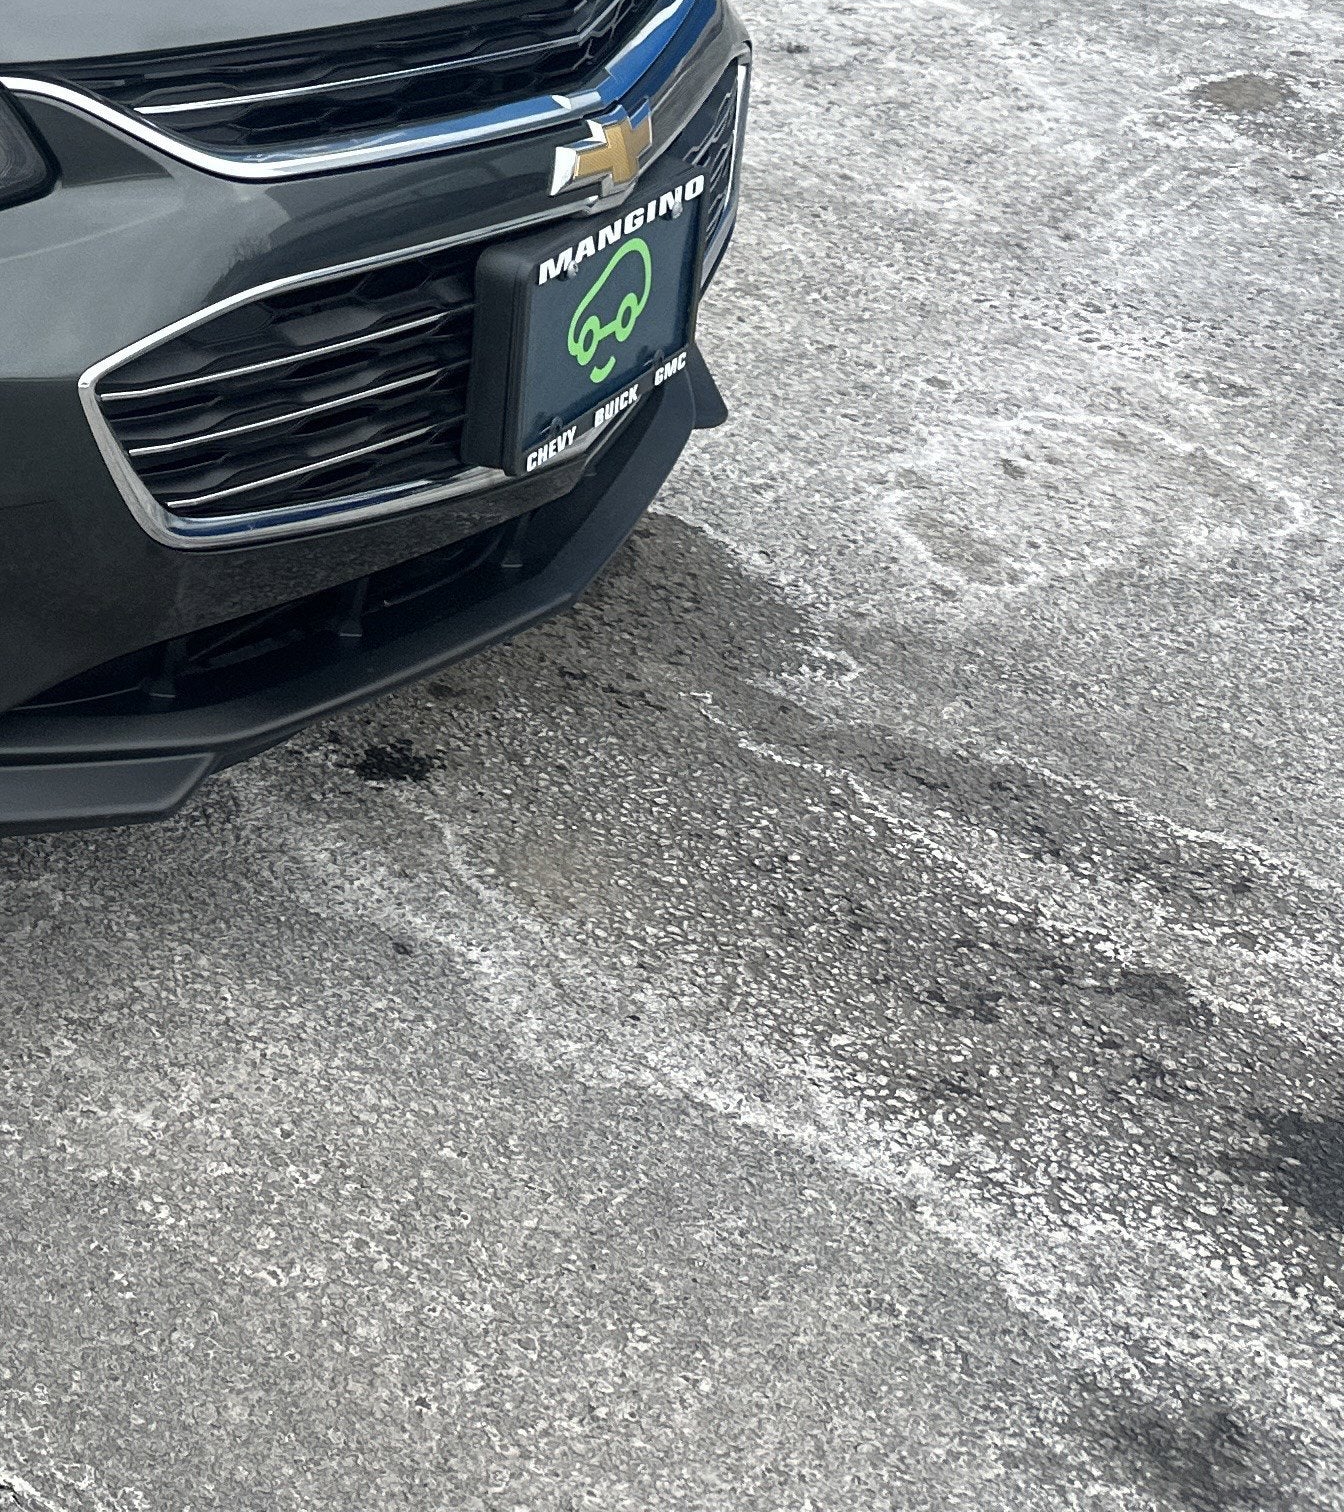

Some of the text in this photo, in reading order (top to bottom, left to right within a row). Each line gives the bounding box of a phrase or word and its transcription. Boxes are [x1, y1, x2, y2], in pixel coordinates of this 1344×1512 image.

[538, 174, 705, 286] MANGINO
[526, 351, 687, 473] CHEVY BUICK GMC
